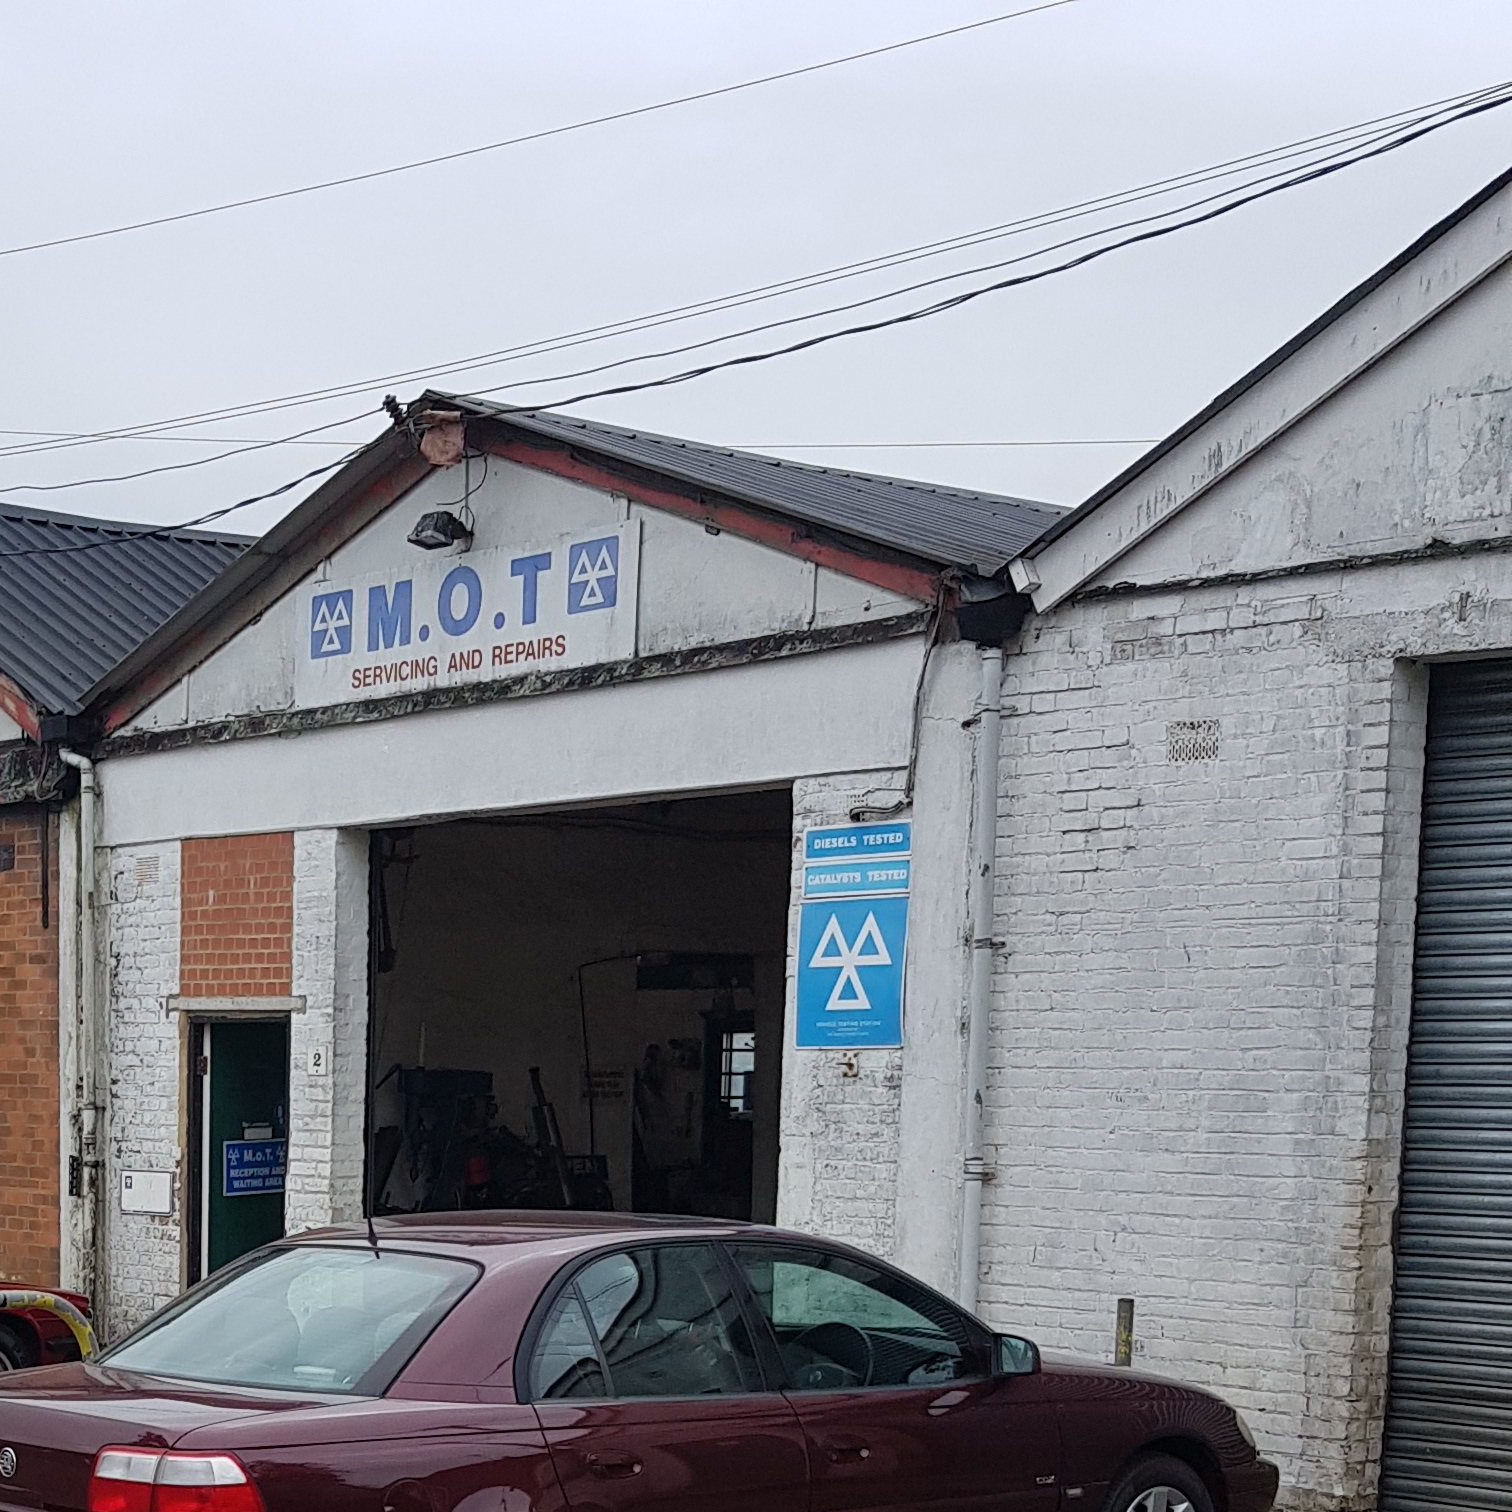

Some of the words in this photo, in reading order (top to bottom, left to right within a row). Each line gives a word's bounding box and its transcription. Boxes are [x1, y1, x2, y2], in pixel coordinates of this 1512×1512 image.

[367, 551, 552, 652] M.O.T
[351, 655, 438, 690] SERVICING
[447, 649, 483, 674] AND
[491, 634, 567, 667] REPAIRS
[813, 836, 857, 850] DIESELS
[862, 832, 904, 846] TESTED
[807, 871, 861, 886] CATALYSTS
[867, 869, 907, 882] TESTED
[312, 1052, 322, 1067] 2
[229, 1167, 270, 1178] RECEPTION
[232, 1178, 263, 1189] WAITING
[264, 1177, 283, 1187] AREA
